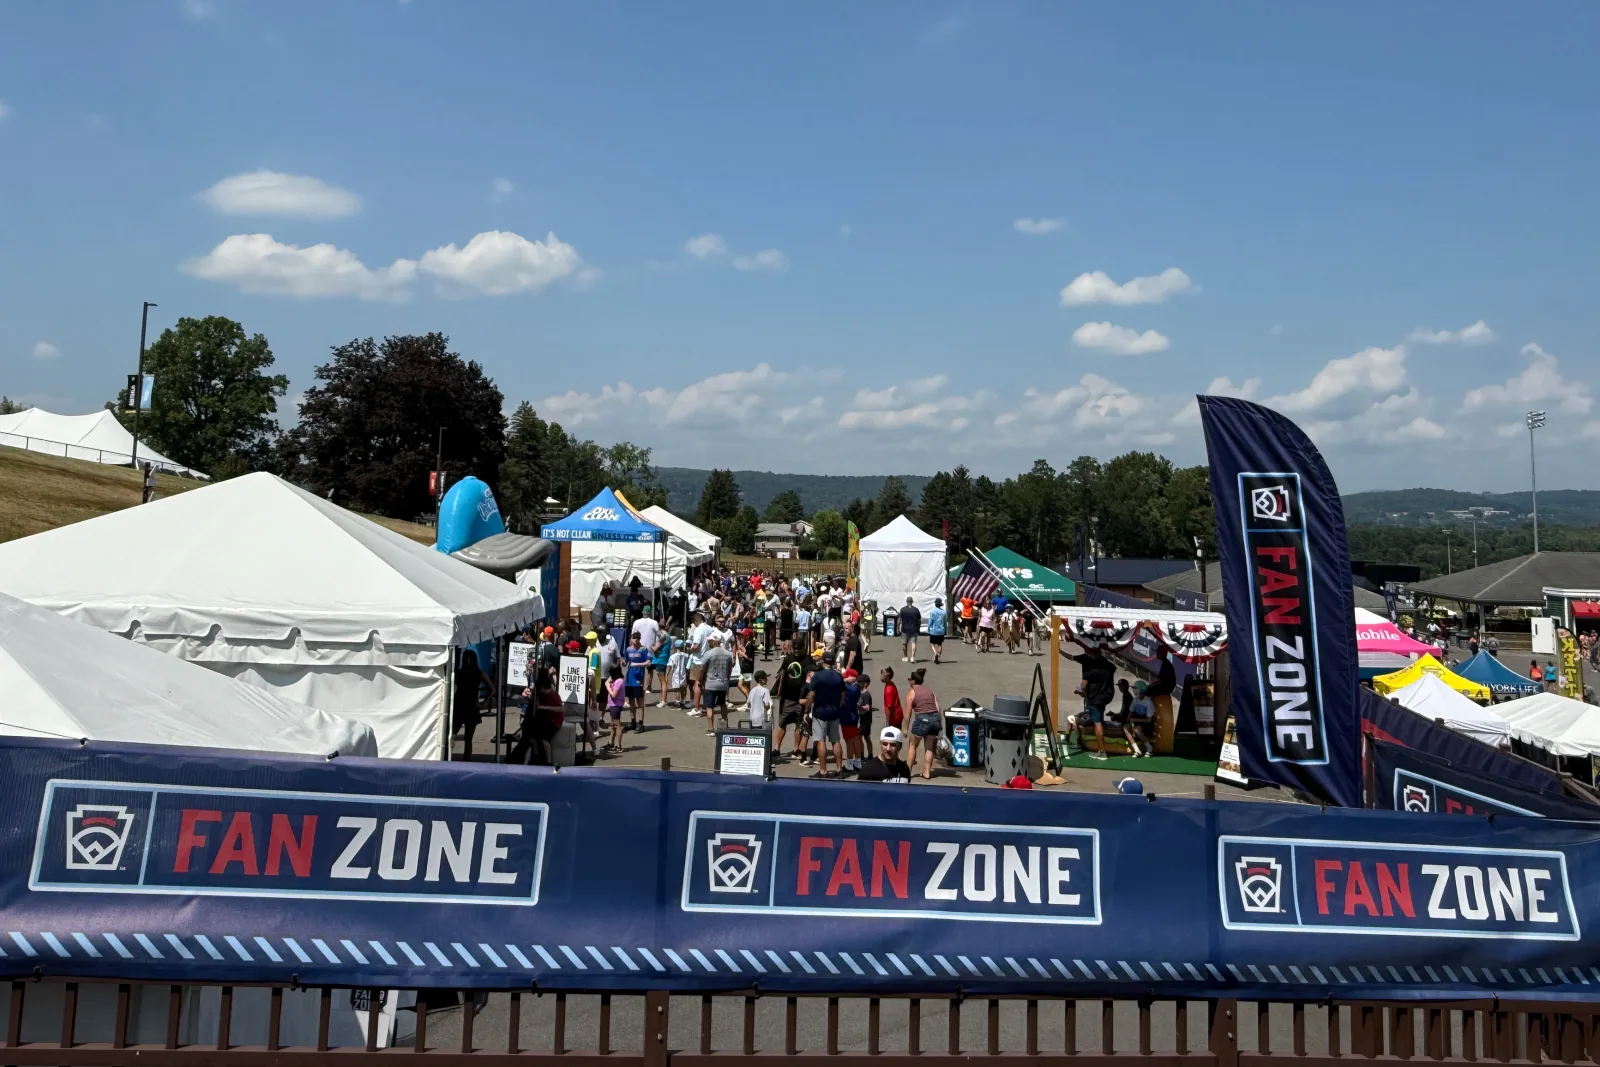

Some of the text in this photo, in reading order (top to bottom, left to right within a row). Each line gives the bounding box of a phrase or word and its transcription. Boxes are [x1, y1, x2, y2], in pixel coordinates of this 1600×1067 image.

[583, 512, 620, 521] CLEAN
[543, 529, 555, 538] IT'S
[557, 530, 569, 539] NOT
[571, 531, 592, 539] CLEAN
[1256, 546, 1314, 751] FAN ZONE
[567, 666, 580, 675] LINE
[561, 674, 585, 685] STARTS
[564, 684, 581, 692] HERE
[1491, 684, 1517, 692] YORK
[1519, 685, 1539, 693] LIFE
[172, 808, 523, 885] FAN ZONE
[795, 835, 1081, 906] FAN ZONE
[1314, 859, 1559, 923] FAN ZONE
